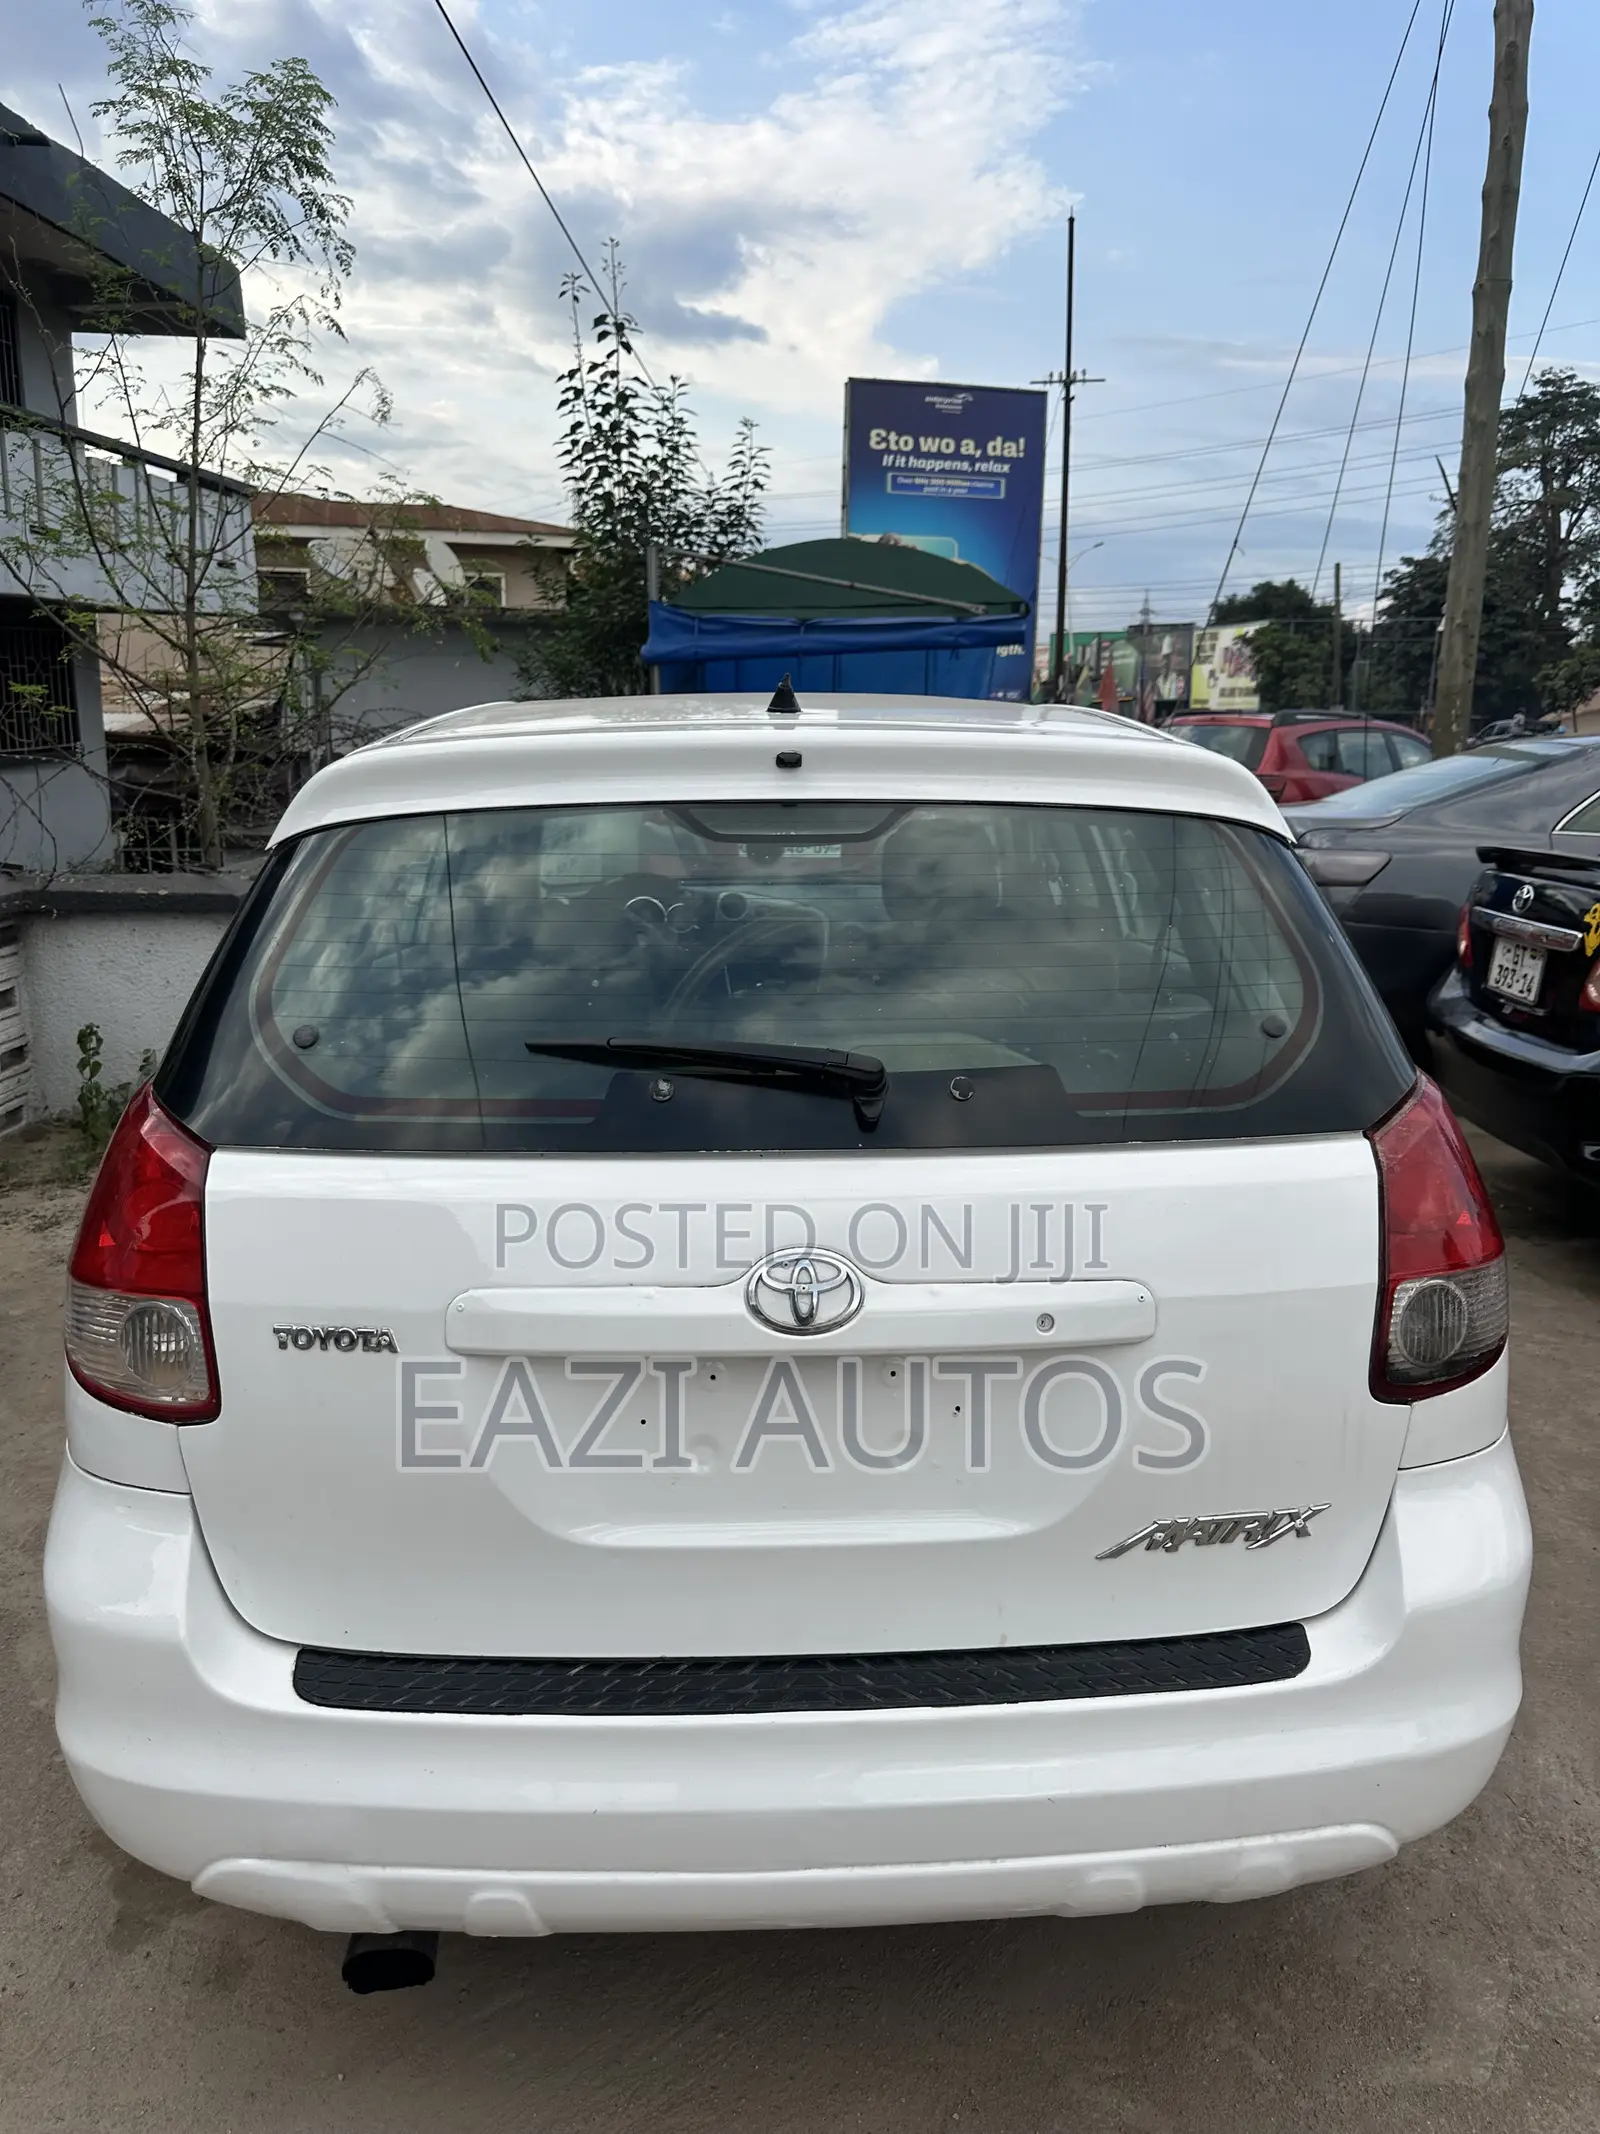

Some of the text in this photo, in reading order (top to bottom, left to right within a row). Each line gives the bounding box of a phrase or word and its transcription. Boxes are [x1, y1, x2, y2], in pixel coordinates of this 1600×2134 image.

[919, 436, 955, 454] wo
[986, 435, 1026, 458] da!
[882, 454, 1012, 473] If it happens, relax
[273, 1323, 400, 1353] TOYOTA
[1095, 1502, 1332, 1559] MATRIX
